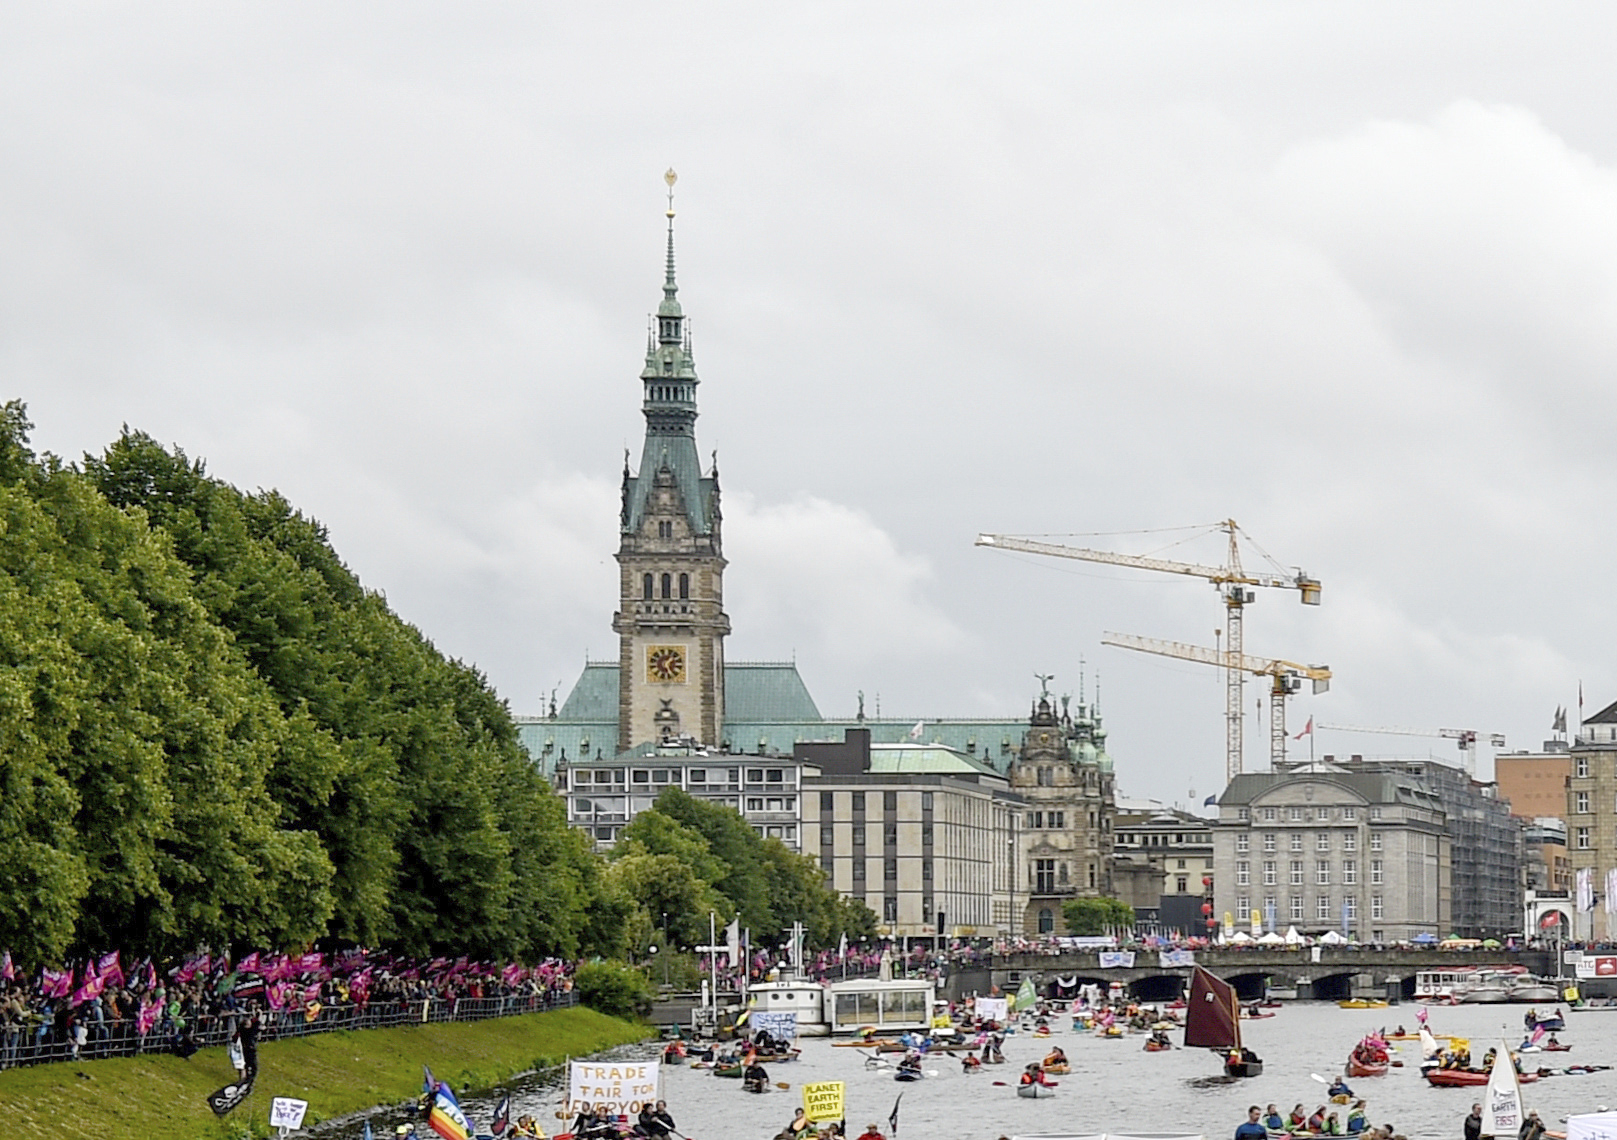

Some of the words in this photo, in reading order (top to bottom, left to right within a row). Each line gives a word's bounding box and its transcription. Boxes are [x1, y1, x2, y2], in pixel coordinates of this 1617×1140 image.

[578, 1066, 647, 1080] TRADE
[807, 1084, 840, 1094] PLANET
[807, 1093, 840, 1104] EARTH
[811, 1102, 838, 1113] FIRST
[1491, 1101, 1516, 1113] EARTH
[1495, 1115, 1517, 1127] FIRST
